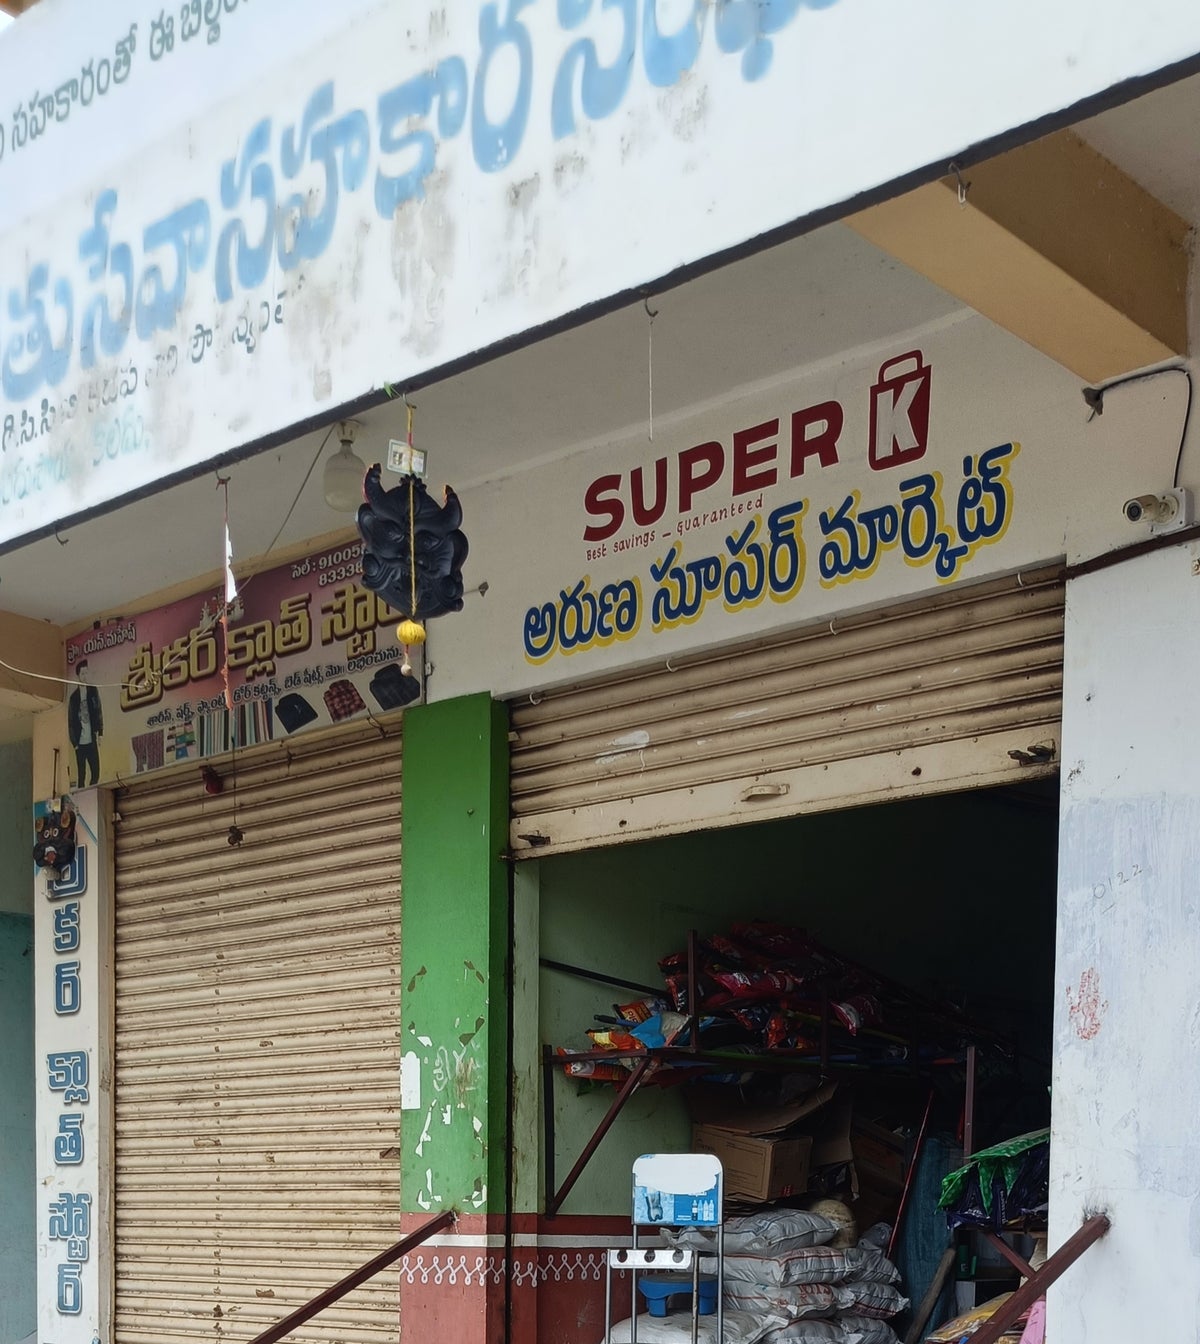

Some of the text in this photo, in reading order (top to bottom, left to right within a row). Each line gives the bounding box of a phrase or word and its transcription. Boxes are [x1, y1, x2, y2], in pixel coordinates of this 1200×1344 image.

[149, 9, 175, 61] ఈ
[583, 374, 929, 543] SUPER K
[318, 543, 366, 571] 91005
[523, 443, 1018, 664] అరుణ సూపర్ మార్కెట్
[586, 543, 608, 561] Best
[613, 529, 656, 553] savings
[225, 593, 313, 680] క్లాత్
